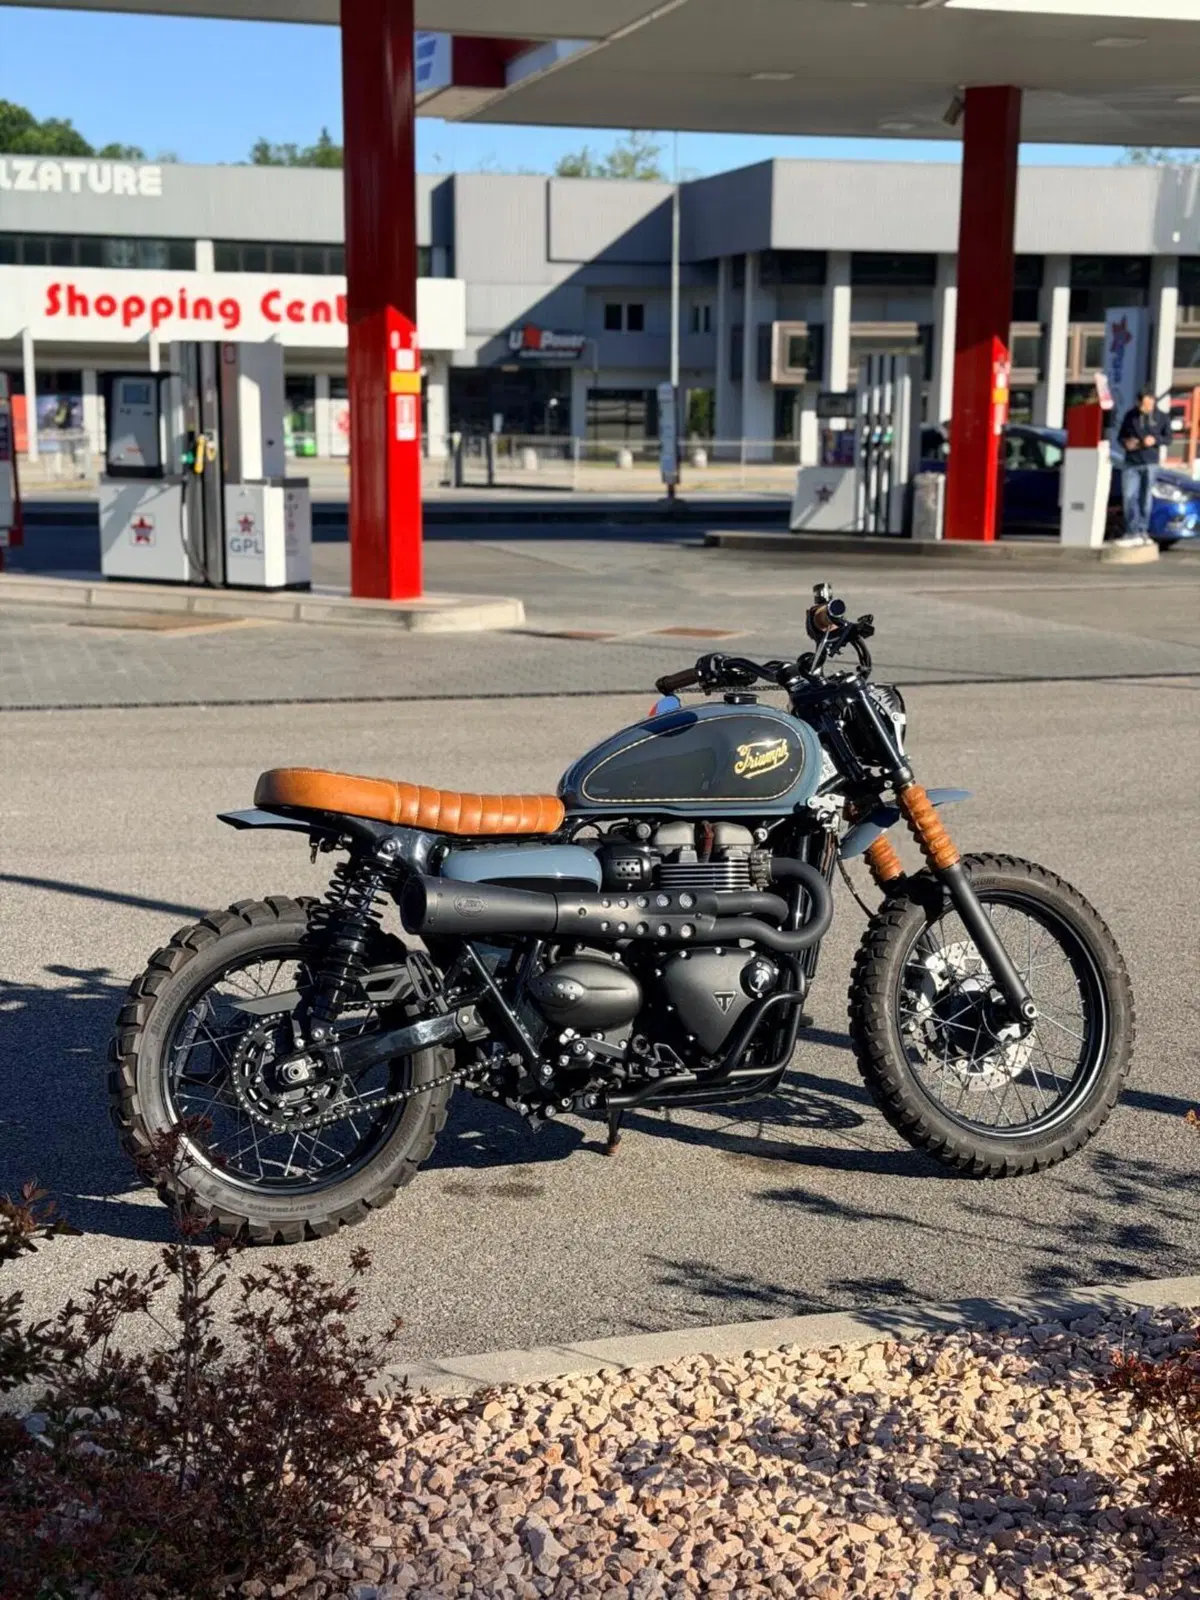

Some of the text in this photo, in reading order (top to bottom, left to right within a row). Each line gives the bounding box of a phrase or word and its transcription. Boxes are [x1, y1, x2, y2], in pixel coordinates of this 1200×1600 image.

[0, 159, 162, 196] LZATURE
[45, 283, 241, 330] Shopping
[230, 537, 264, 554] GPL
[734, 738, 789, 779] Triumph
